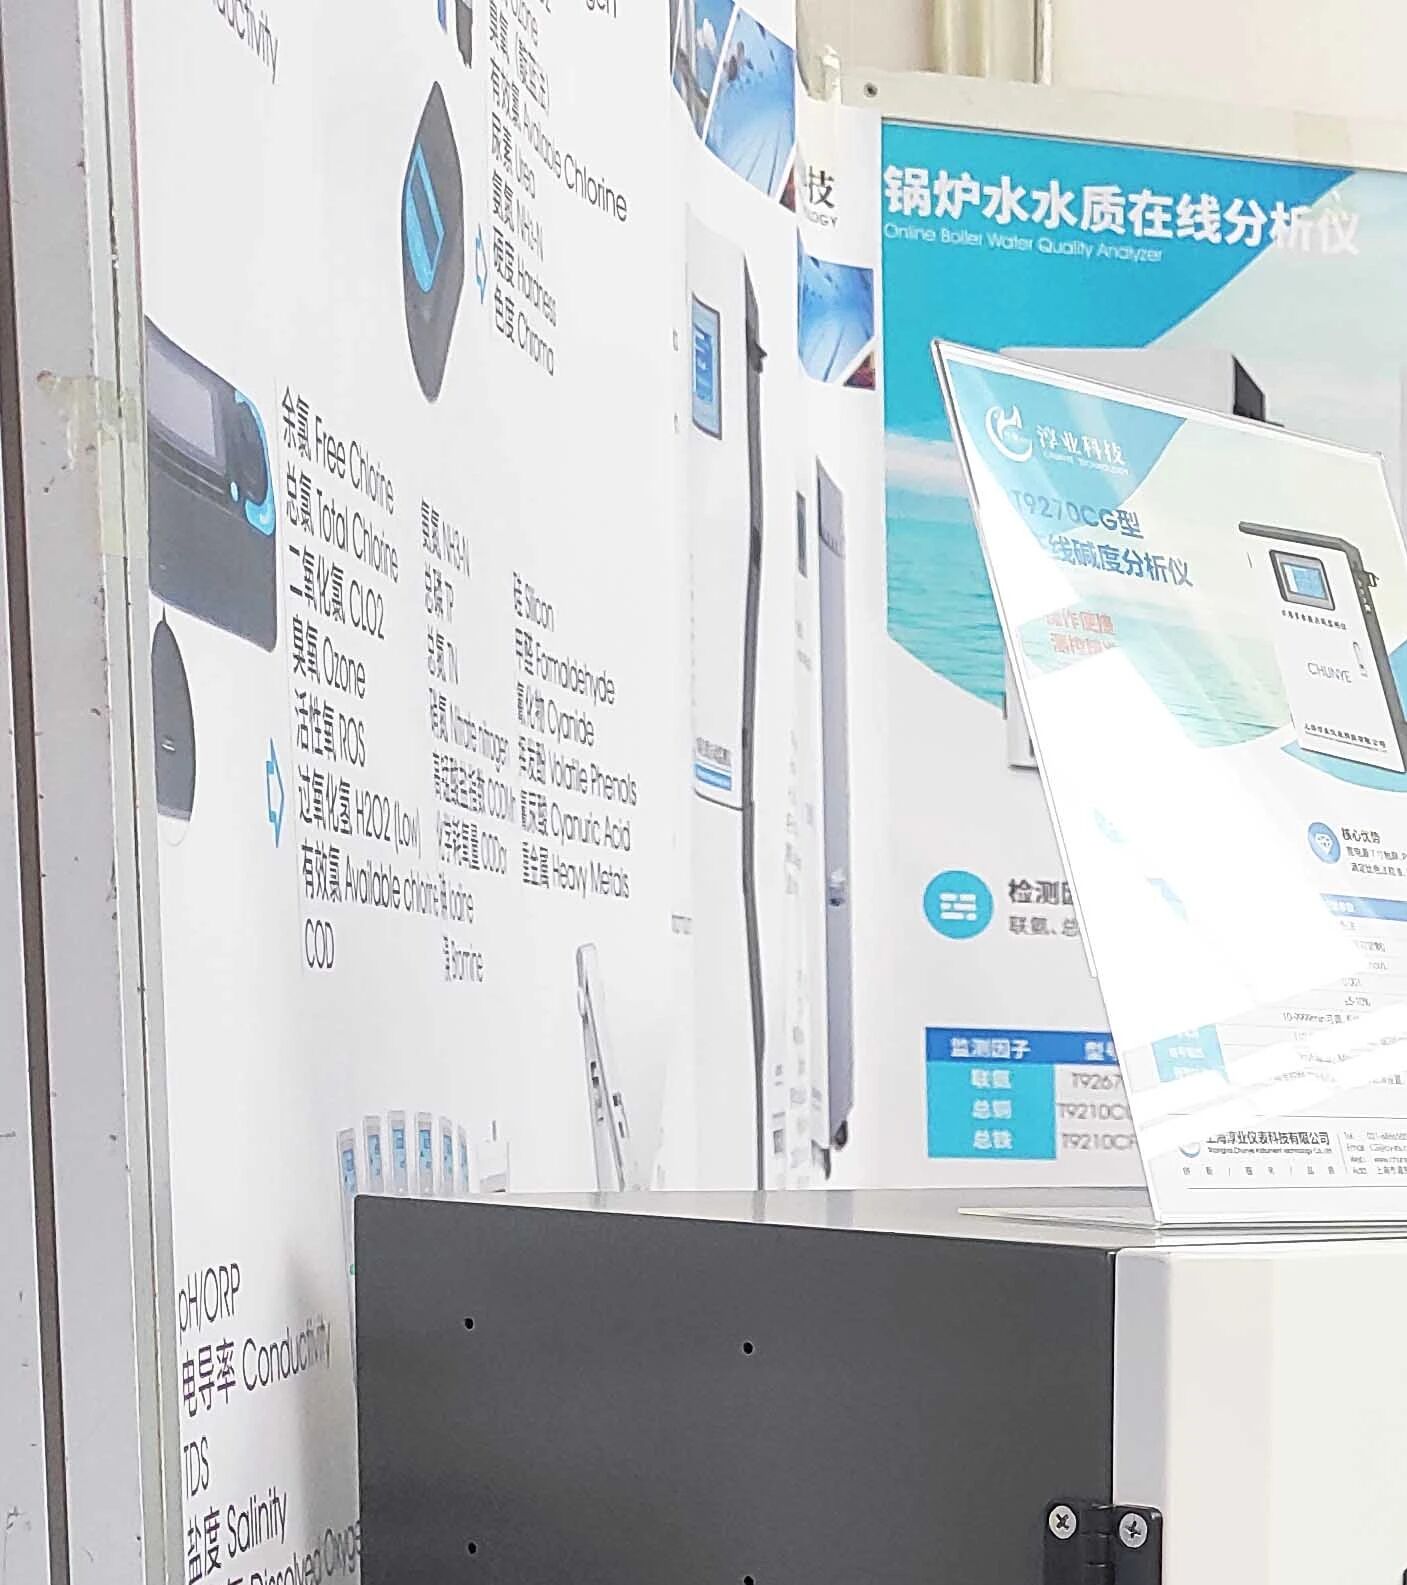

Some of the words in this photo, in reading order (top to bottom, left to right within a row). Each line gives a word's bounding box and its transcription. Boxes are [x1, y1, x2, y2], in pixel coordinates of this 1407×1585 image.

[564, 153, 628, 223] Chlorine
[884, 164, 1360, 257] 锅炉水水质在线分析仪
[884, 223, 937, 242] Online
[940, 227, 982, 247] Boiler
[986, 231, 1034, 252] Water
[1037, 237, 1093, 260] Quality
[1097, 243, 1163, 264] Analyzer
[282, 386, 311, 462] 余氯
[315, 416, 346, 480] Free
[349, 440, 394, 516] Chlorine
[286, 461, 314, 537] 总氯
[316, 489, 348, 553] Total
[352, 511, 398, 583] Chlorine
[289, 545, 345, 625] 二氧化氯
[293, 614, 320, 685] 臭氧
[323, 636, 366, 700] Ozone
[294, 688, 337, 762] 活性氧
[338, 711, 366, 768] ROS
[547, 698, 596, 748] Cyanide
[298, 763, 353, 837] 过氧化氢
[355, 788, 391, 843] H2O2
[548, 751, 588, 797] Volatile
[590, 763, 638, 807] Phenols
[550, 801, 601, 847] Cyanuric
[603, 814, 632, 853] Acid
[301, 837, 342, 902] 有效氯
[345, 855, 401, 910] Available
[552, 851, 588, 899] Heavy
[590, 860, 631, 900] Metals
[304, 918, 335, 970] COD
[950, 1037, 1032, 1060] 监测因子
[178, 1261, 241, 1346] pH/ORP
[181, 1338, 237, 1418] 电导率
[241, 1318, 332, 1392] Conductivity
[183, 1435, 210, 1500] TDS
[227, 1488, 287, 1558] Salinity
